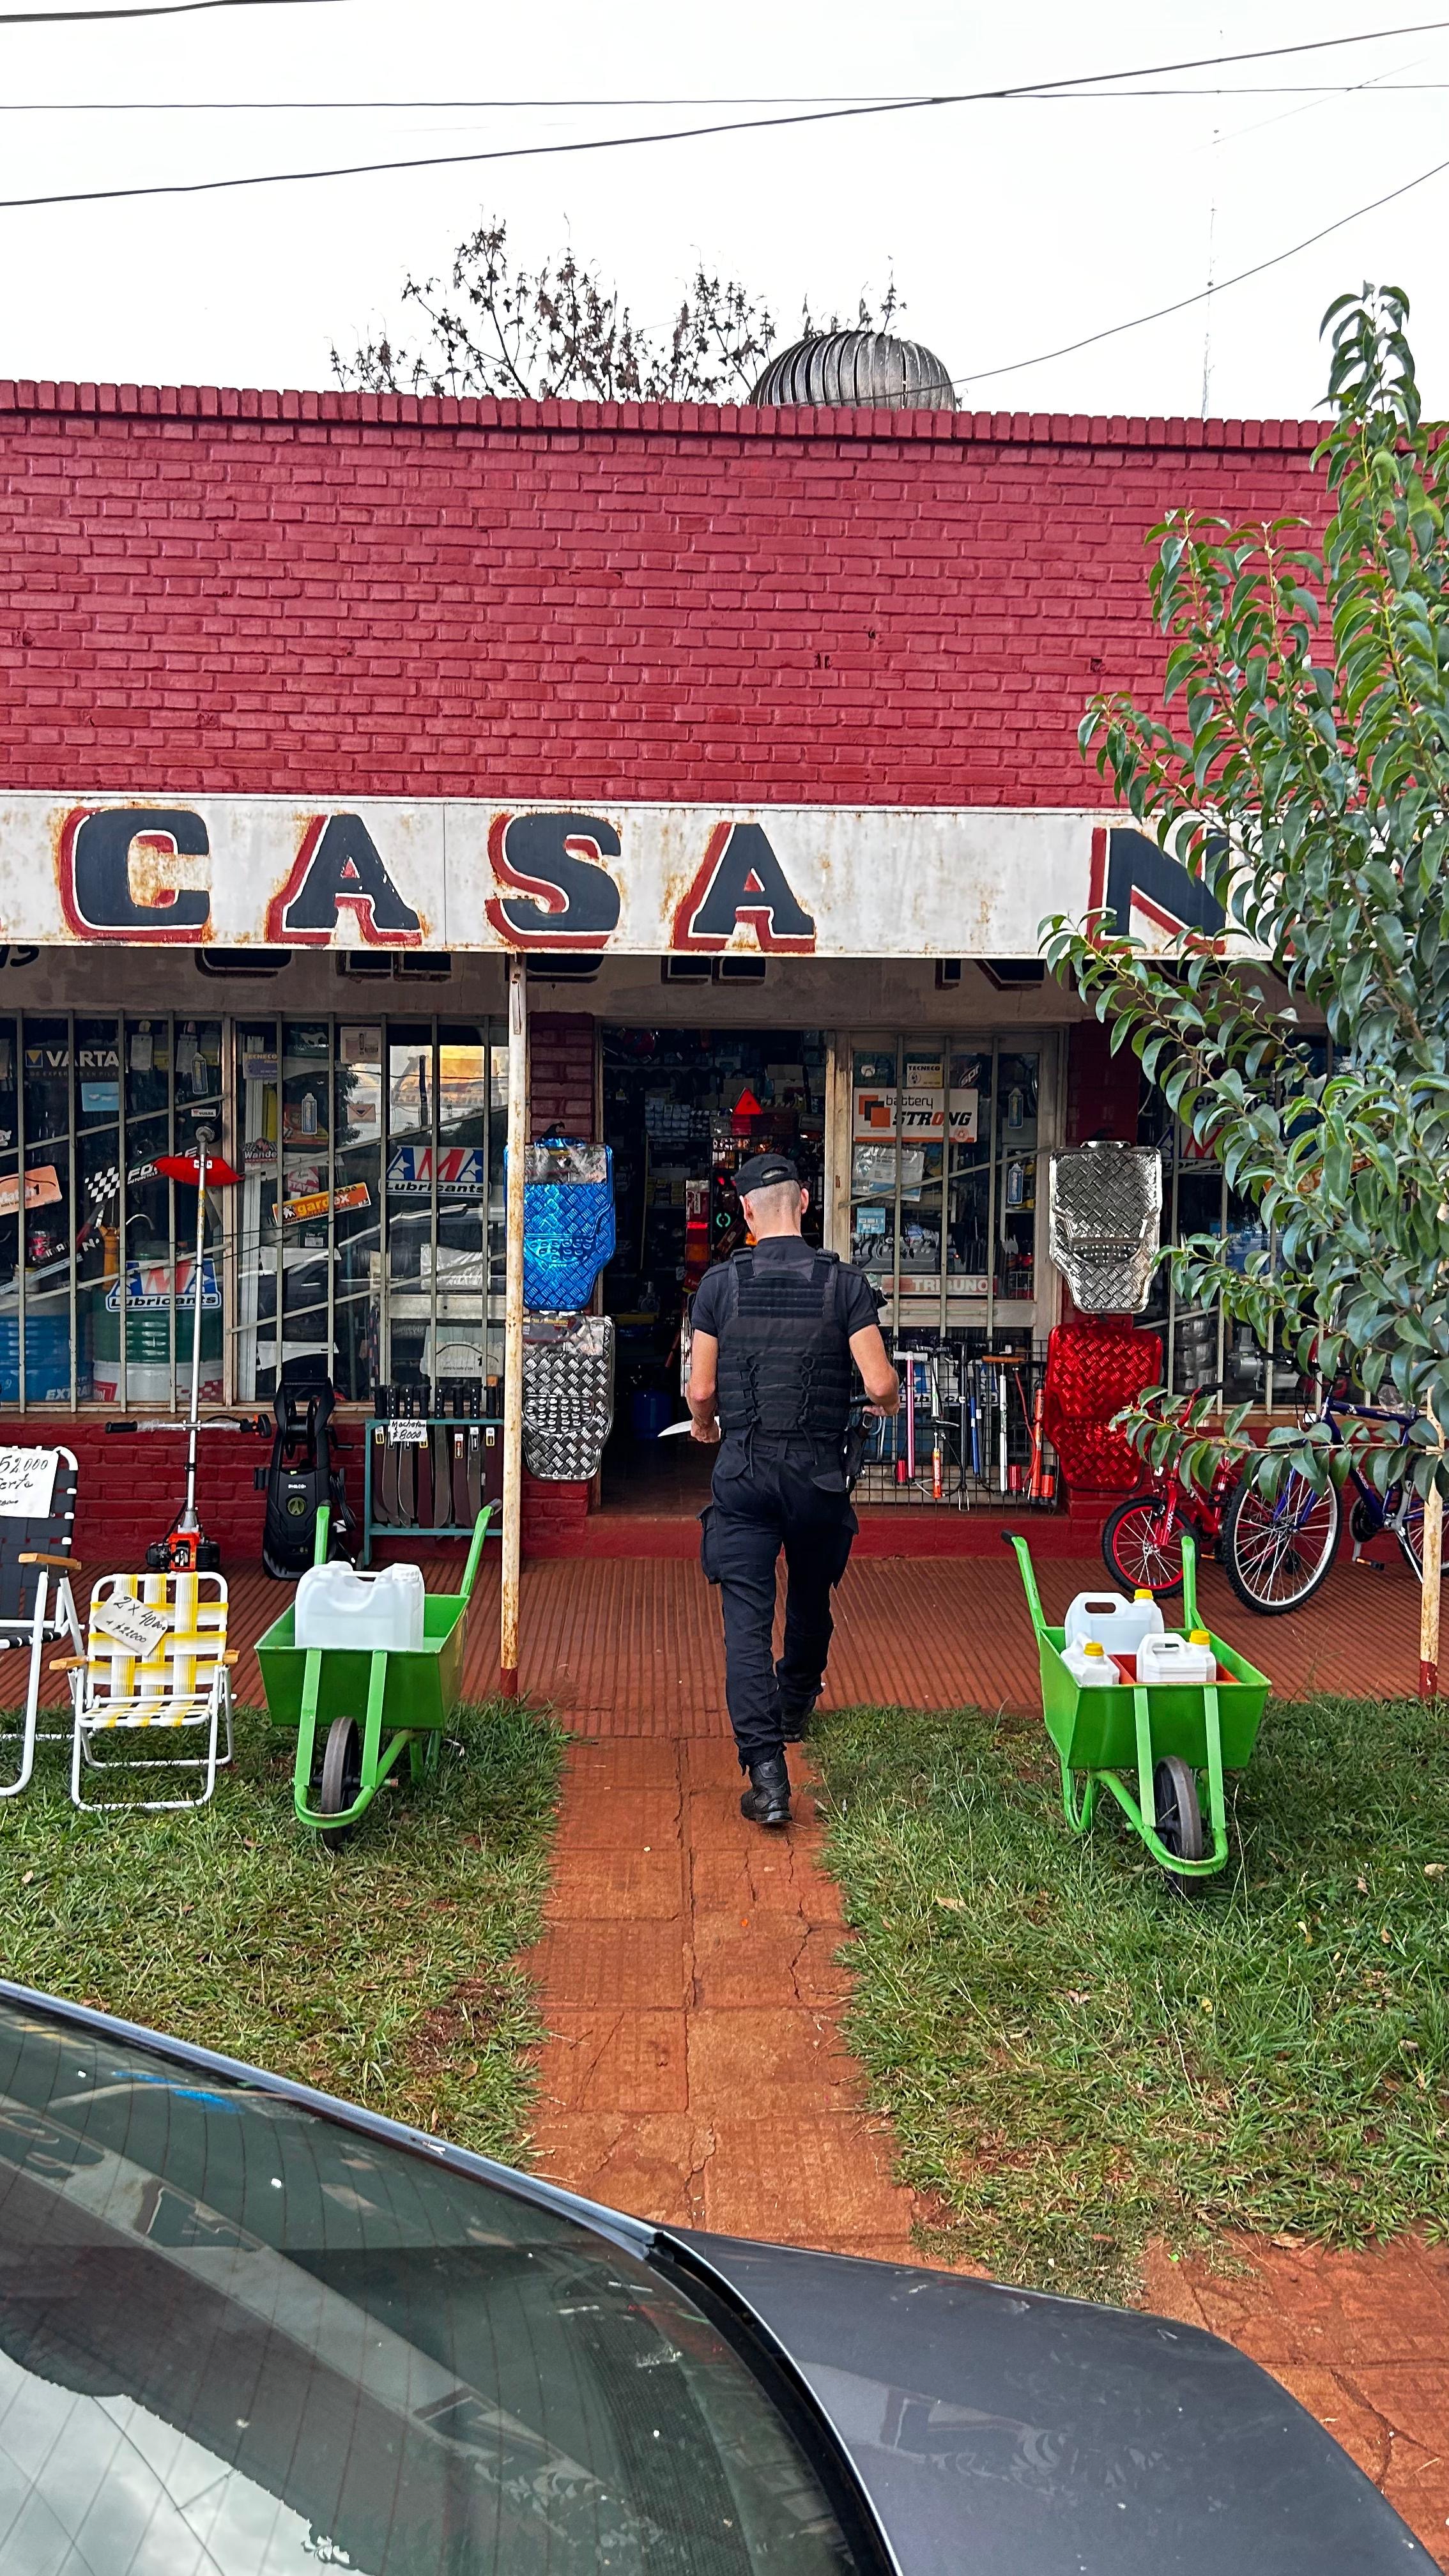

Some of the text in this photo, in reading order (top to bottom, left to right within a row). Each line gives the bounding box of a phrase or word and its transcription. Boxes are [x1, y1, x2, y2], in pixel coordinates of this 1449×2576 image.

[59, 806, 816, 952] CASA
[46, 1051, 120, 1067] VARTA
[885, 1095, 933, 1109] battery
[892, 1111, 972, 1126] STRONG
[385, 1147, 484, 1181] AMA
[386, 1182, 484, 1193] Lubricants
[912, 1278, 988, 1292] TRIBUNO
[111, 1297, 216, 1307] Lubricants
[113, 1596, 132, 1609] 2
